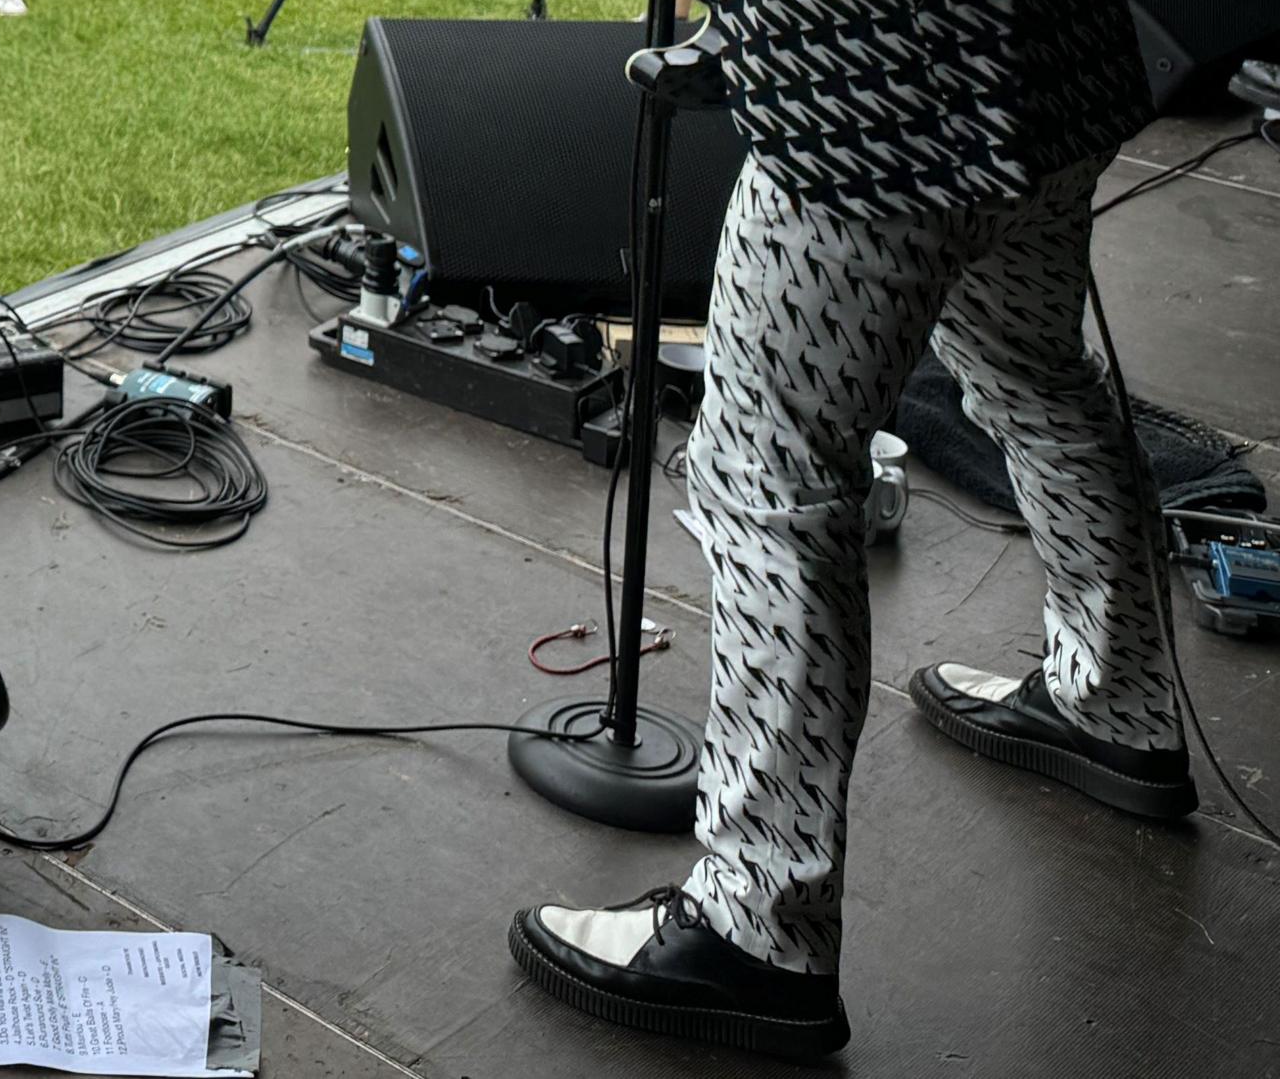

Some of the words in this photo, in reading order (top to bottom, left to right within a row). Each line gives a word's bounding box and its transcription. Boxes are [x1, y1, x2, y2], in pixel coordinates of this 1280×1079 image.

[21, 982, 31, 1002] Again
[80, 987, 90, 998] Fire
[106, 977, 116, 994] Jude
[8, 987, 17, 1004] Rock
[32, 988, 42, 1002] Sue
[23, 1003, 33, 1021] Twist
[85, 1008, 96, 1025] Balls
